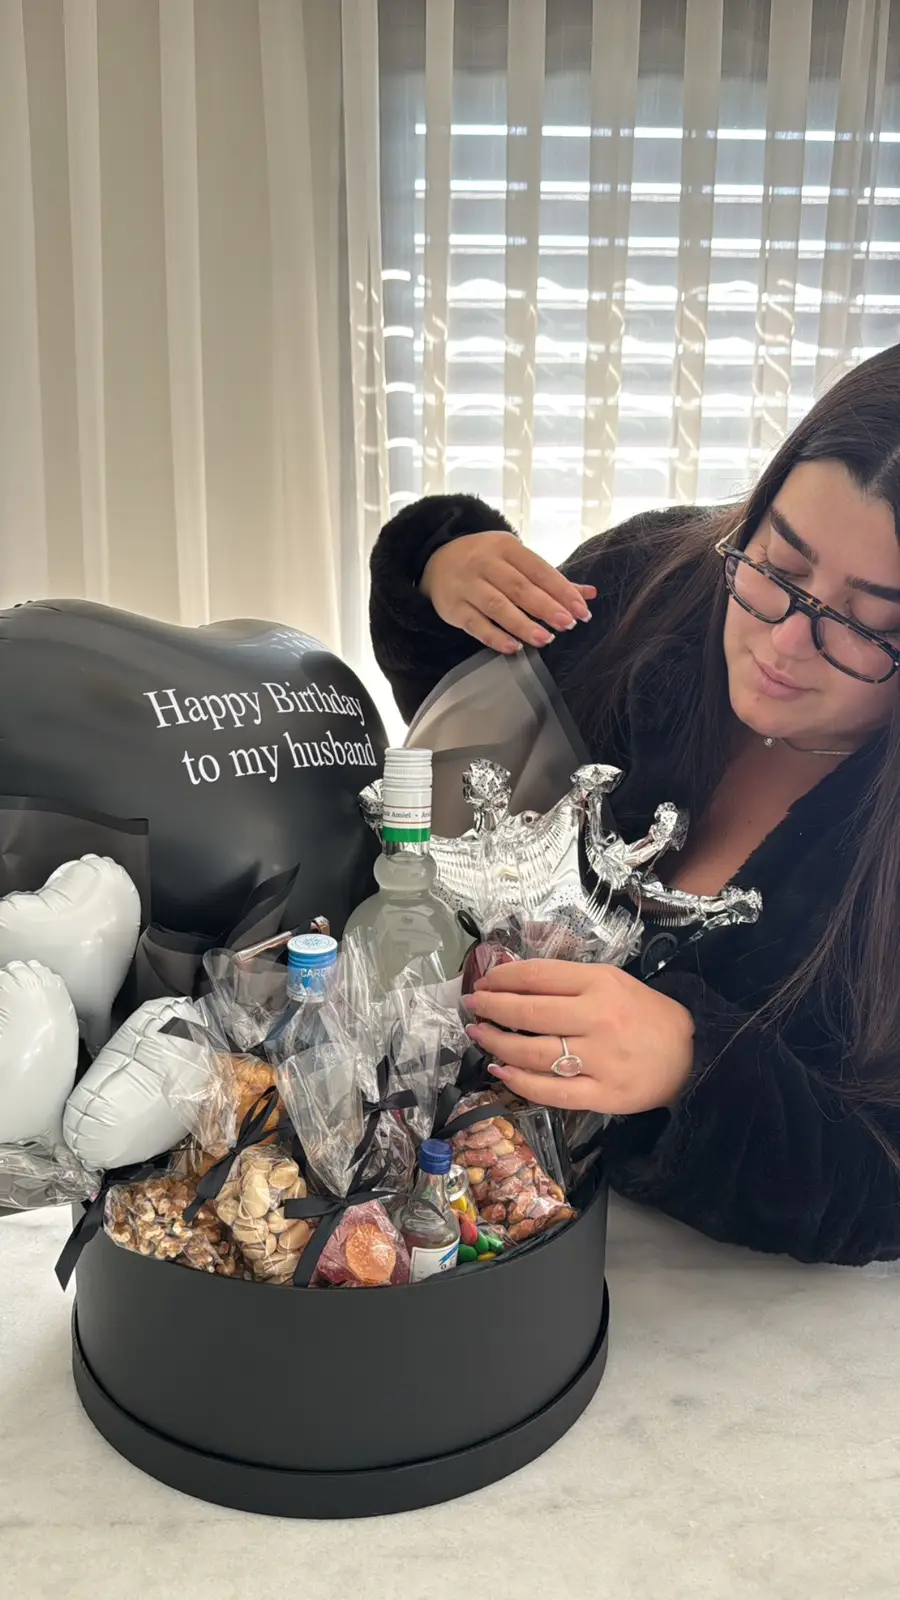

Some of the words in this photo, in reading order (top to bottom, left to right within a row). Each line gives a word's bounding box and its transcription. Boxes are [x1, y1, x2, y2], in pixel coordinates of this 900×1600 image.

[143, 688, 262, 731] Happy
[262, 681, 365, 726] Birthday
[181, 750, 221, 785] to
[228, 744, 279, 783] my
[283, 730, 377, 769] husband
